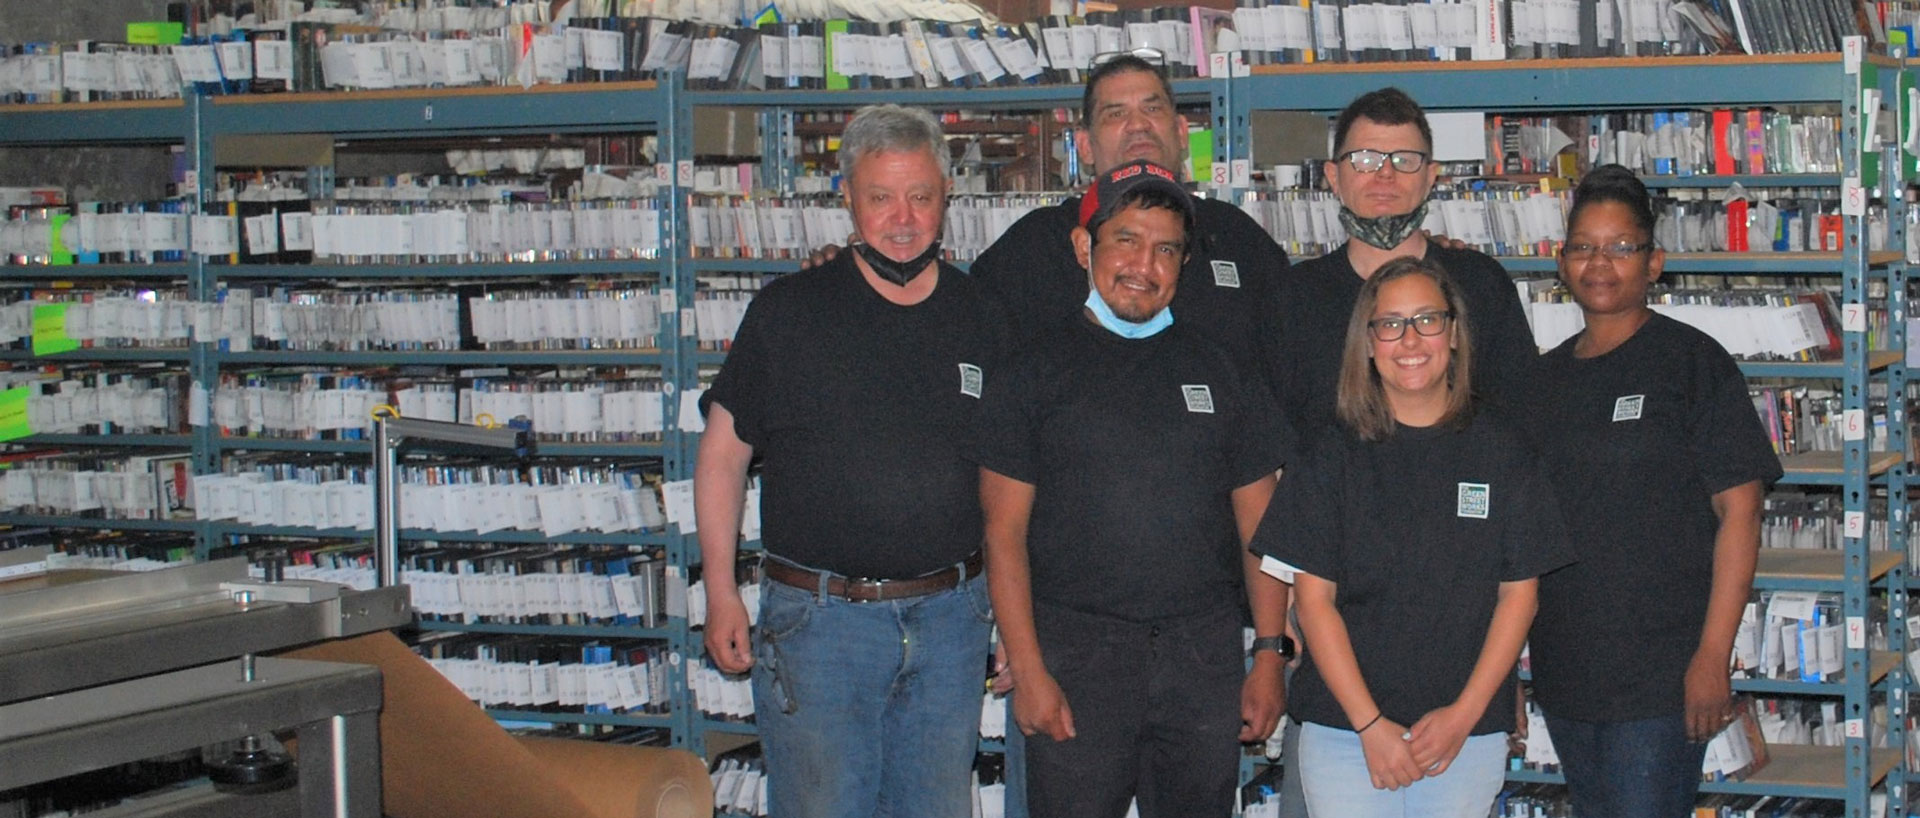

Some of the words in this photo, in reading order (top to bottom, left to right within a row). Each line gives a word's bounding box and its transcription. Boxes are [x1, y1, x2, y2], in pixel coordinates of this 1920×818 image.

[1214, 167, 1226, 184] 8
[1849, 186, 1860, 208] 8
[1848, 309, 1857, 325] 7
[1849, 413, 1857, 432] 6
[1850, 515, 1860, 530] 5
[1850, 622, 1860, 641] 4
[1850, 722, 1858, 736] 3
